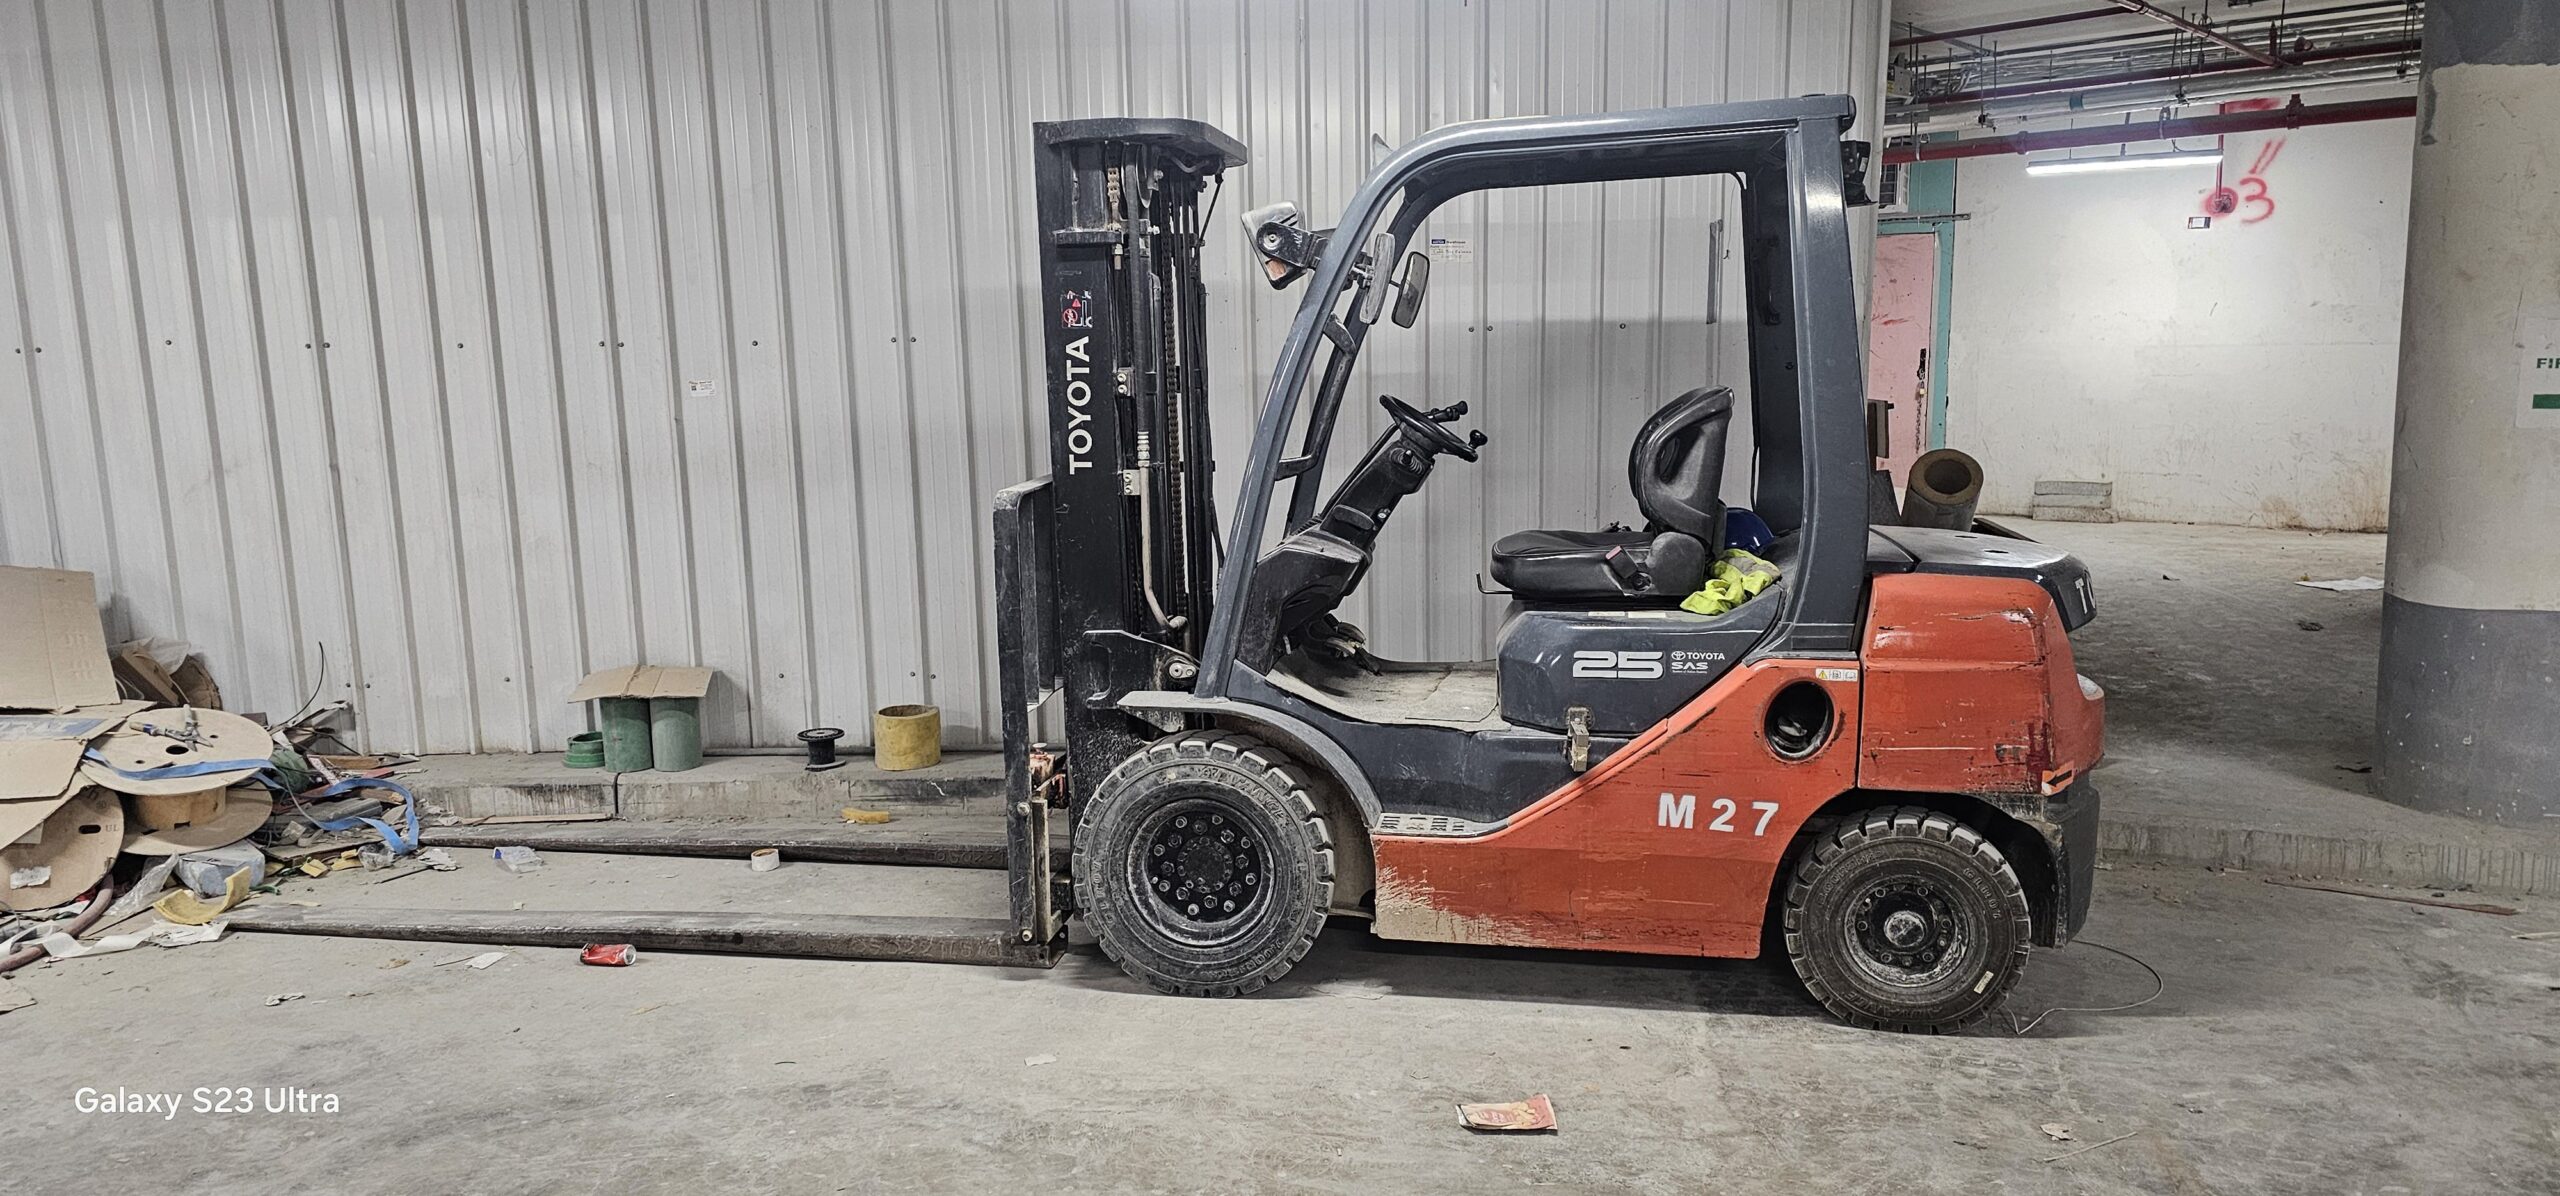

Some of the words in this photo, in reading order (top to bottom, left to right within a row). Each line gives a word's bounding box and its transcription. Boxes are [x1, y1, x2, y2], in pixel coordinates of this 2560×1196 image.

[1065, 335, 1093, 475] TOYOTA
[1572, 650, 1664, 679] 25
[1671, 661, 1709, 670] SAS
[1686, 652, 1726, 661] TOYOTA
